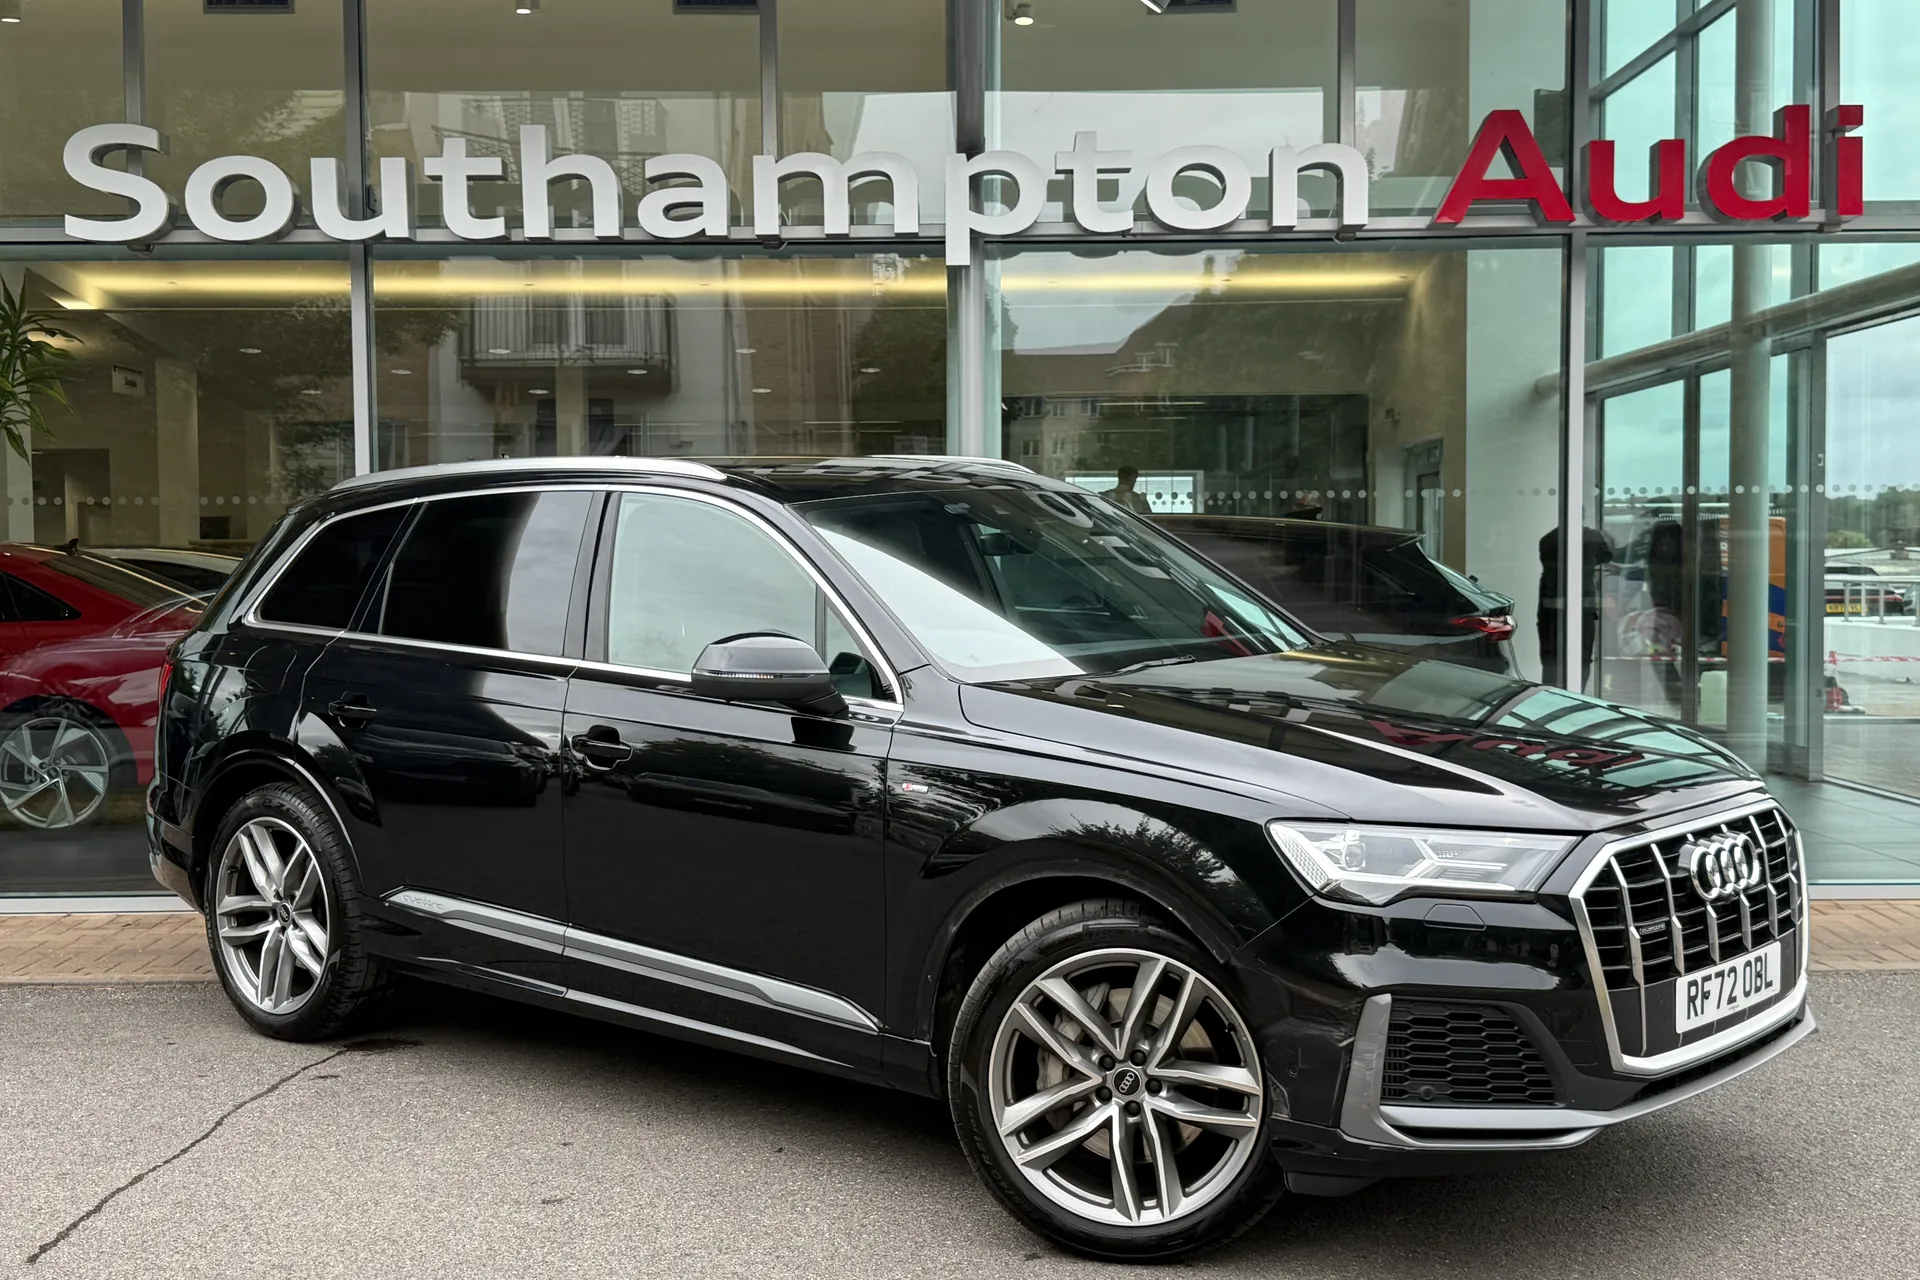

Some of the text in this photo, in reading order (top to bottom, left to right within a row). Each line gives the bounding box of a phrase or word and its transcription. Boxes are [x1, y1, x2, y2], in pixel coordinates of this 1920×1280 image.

[62, 104, 1864, 266] Southampton Audi
[1687, 952, 1773, 1020] RF72 OBL
